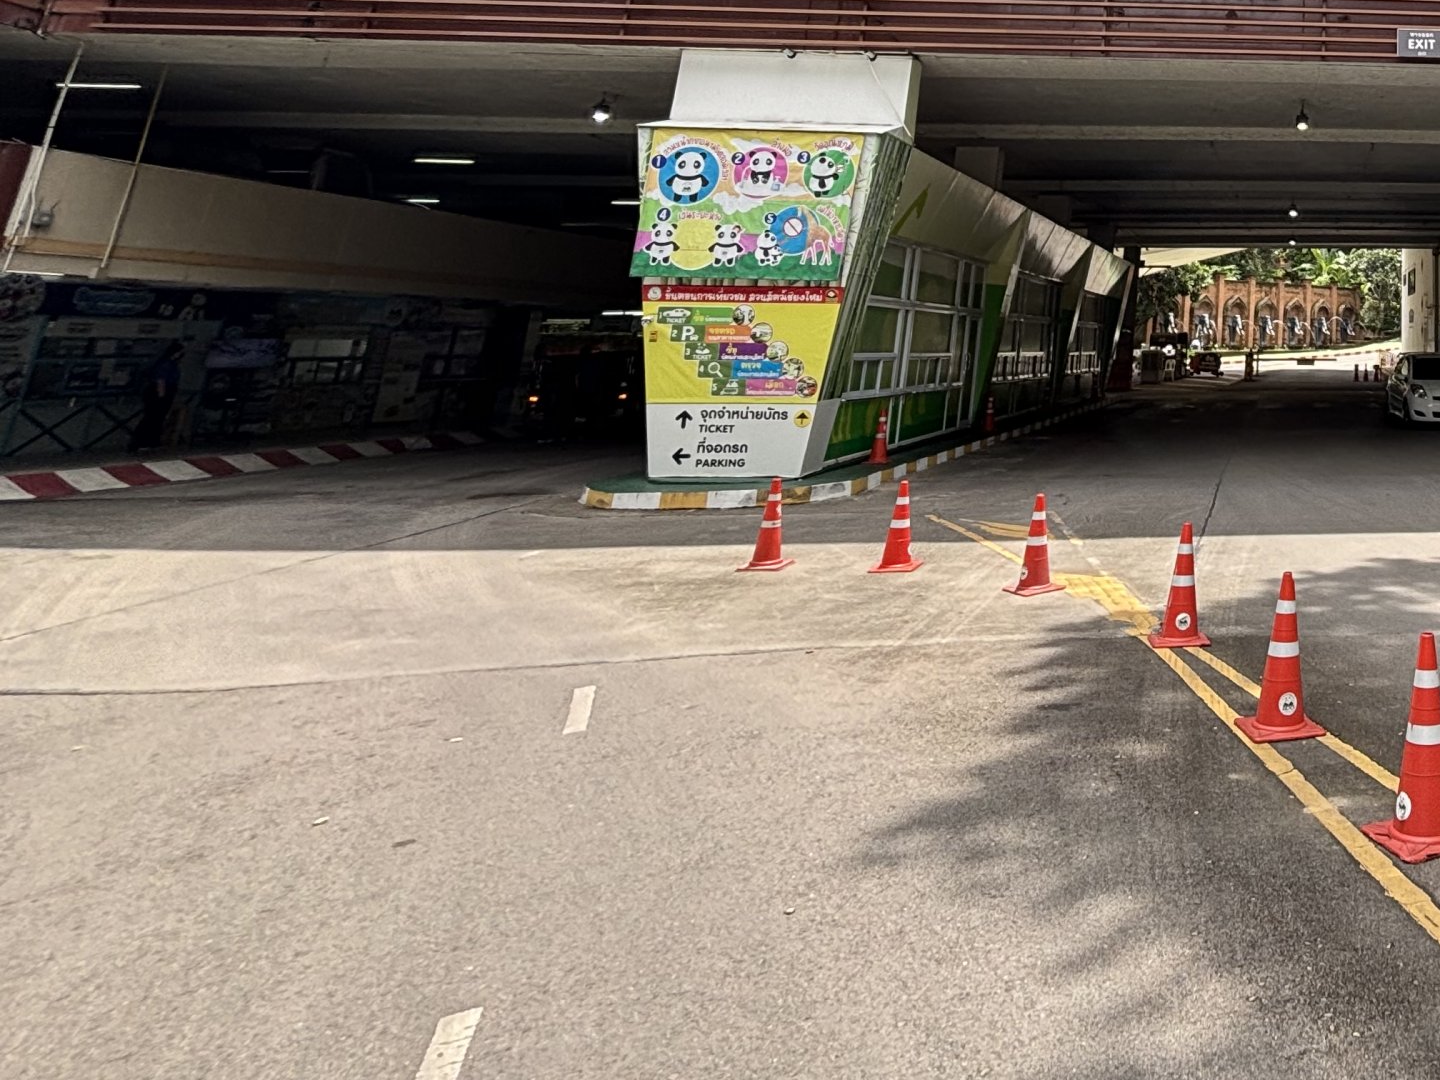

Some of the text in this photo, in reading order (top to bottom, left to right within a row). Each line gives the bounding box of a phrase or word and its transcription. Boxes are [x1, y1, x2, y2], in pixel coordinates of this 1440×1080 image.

[1408, 38, 1436, 50] EXIT
[734, 153, 742, 164] 2
[800, 152, 808, 162] 3
[659, 209, 667, 220] 4
[766, 214, 775, 224] 5
[681, 326, 695, 341] P
[700, 406, 789, 423] จุดจำหน่ายบัตร
[699, 424, 735, 434] TICKET
[697, 437, 748, 454] ที่จอดรถ
[695, 458, 746, 468] PARKING
